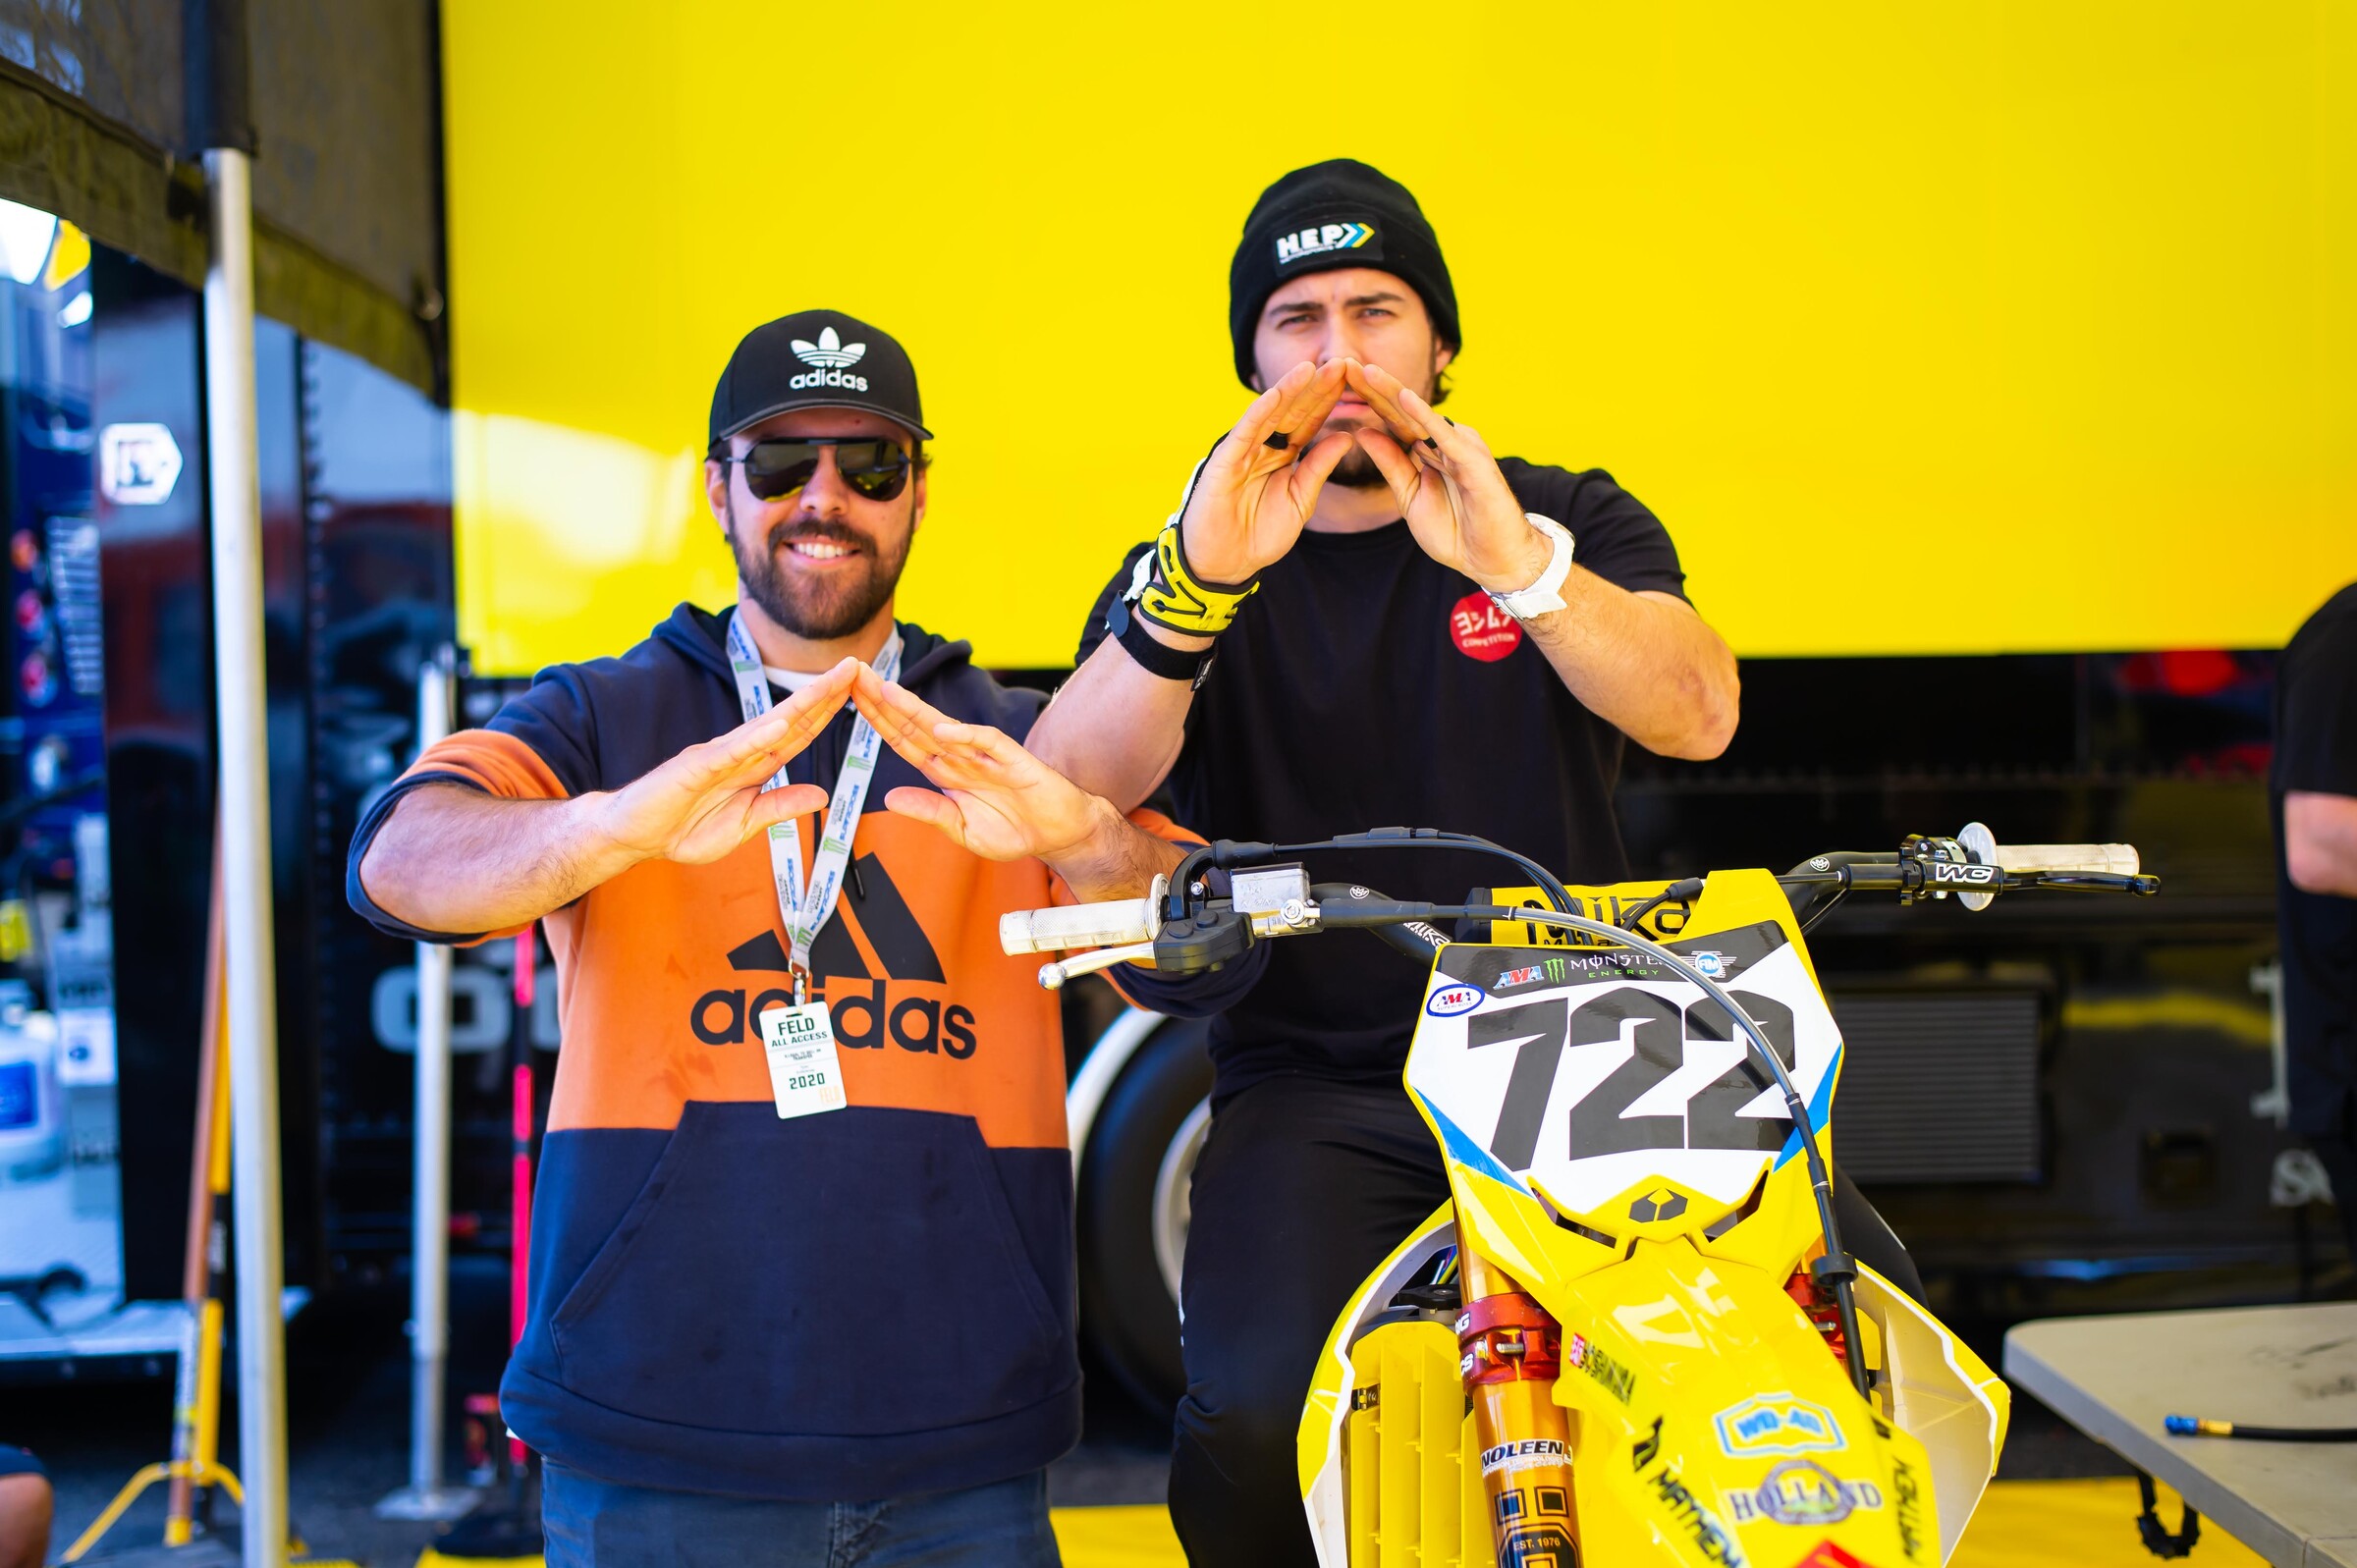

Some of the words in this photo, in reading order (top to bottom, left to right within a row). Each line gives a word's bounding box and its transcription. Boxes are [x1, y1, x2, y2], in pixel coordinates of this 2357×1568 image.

[1277, 224, 1343, 258] HEP
[790, 369, 868, 392] adidas
[1570, 952, 1665, 971] MONSTE
[1698, 958, 1719, 971] FIM
[1493, 965, 1545, 990] AMA
[1588, 969, 1660, 978] ENERGY
[1437, 992, 1472, 1006] AMA
[690, 979, 977, 1060] adas
[778, 1017, 815, 1036] FELD
[771, 1039, 789, 1048] ALL
[791, 1031, 828, 1045] ACCESS
[789, 1072, 826, 1090] 2020
[1467, 987, 1796, 1172] 722
[1481, 1440, 1563, 1469] NOLEEN
[1513, 1540, 1535, 1550] EST.
[1537, 1538, 1561, 1547] 1976
